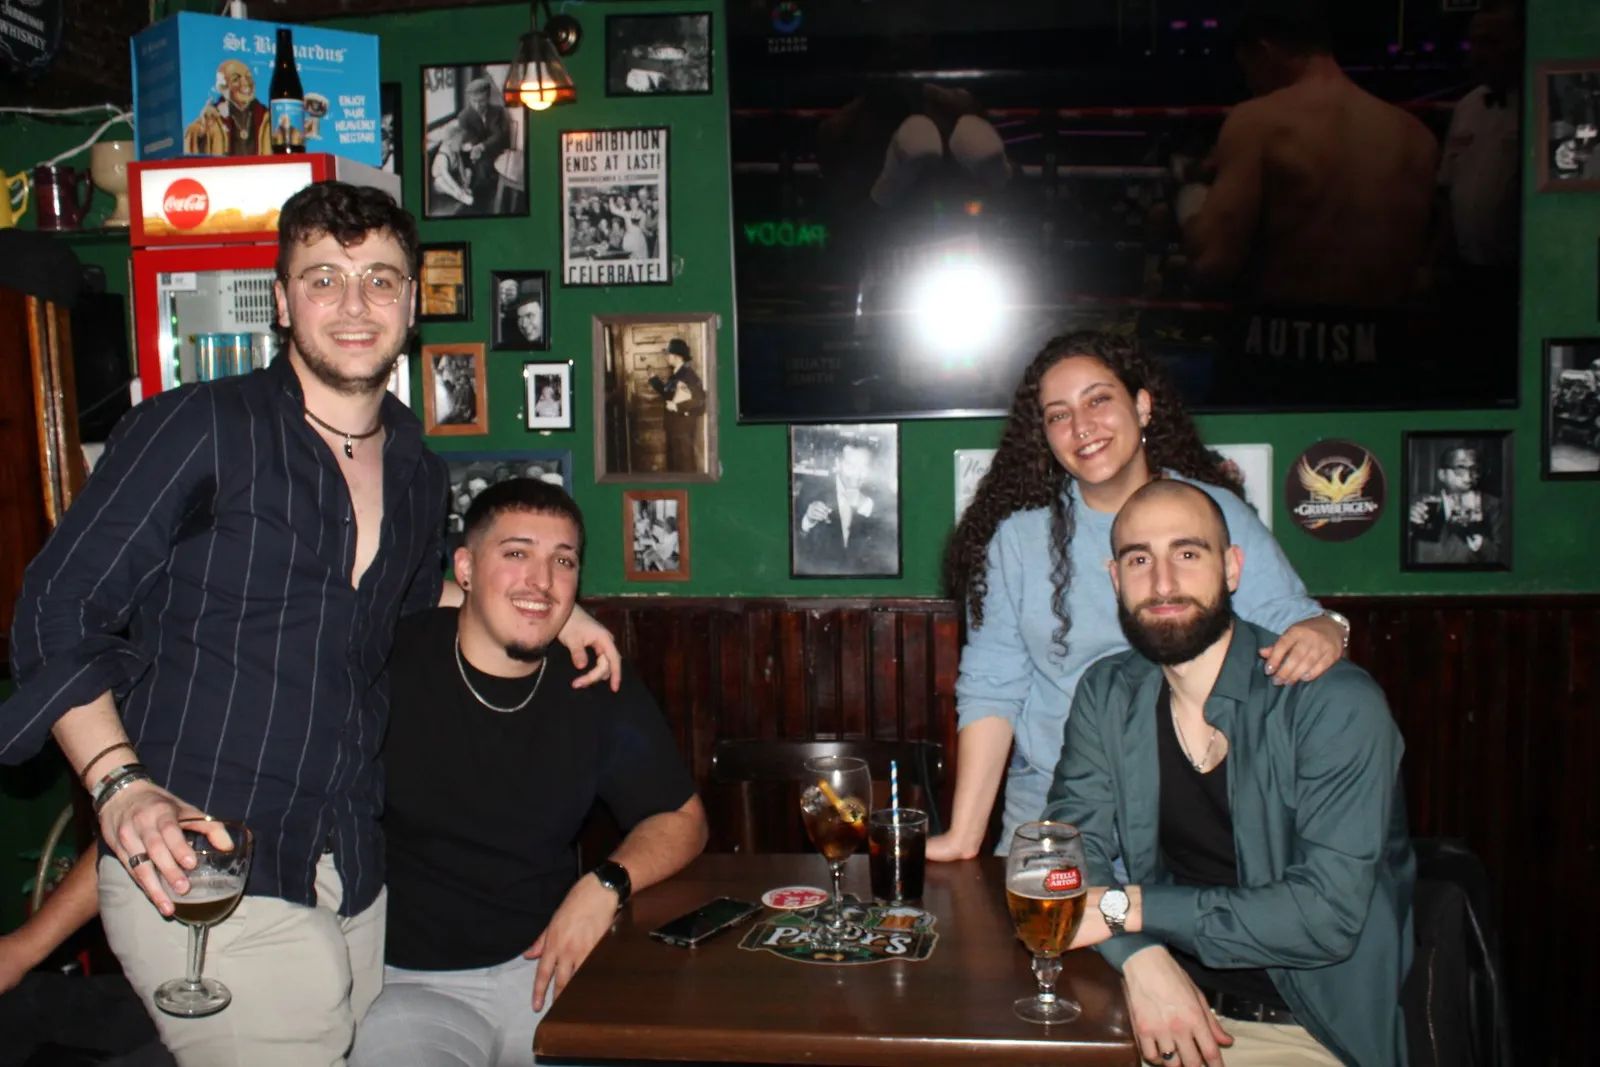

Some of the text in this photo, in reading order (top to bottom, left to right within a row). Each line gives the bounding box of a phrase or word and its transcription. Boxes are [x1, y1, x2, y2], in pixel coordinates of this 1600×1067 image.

[0, 20, 47, 51] WHISKEY
[222, 32, 250, 52] St.
[566, 129, 660, 152] PROHIBITION
[566, 153, 661, 172] ENDS AT LAST!
[568, 263, 661, 284] CELEBRATE!
[1299, 501, 1376, 515] GRIMBERGEN
[1050, 871, 1077, 880] STELLA
[1050, 878, 1078, 887] ARTOIS
